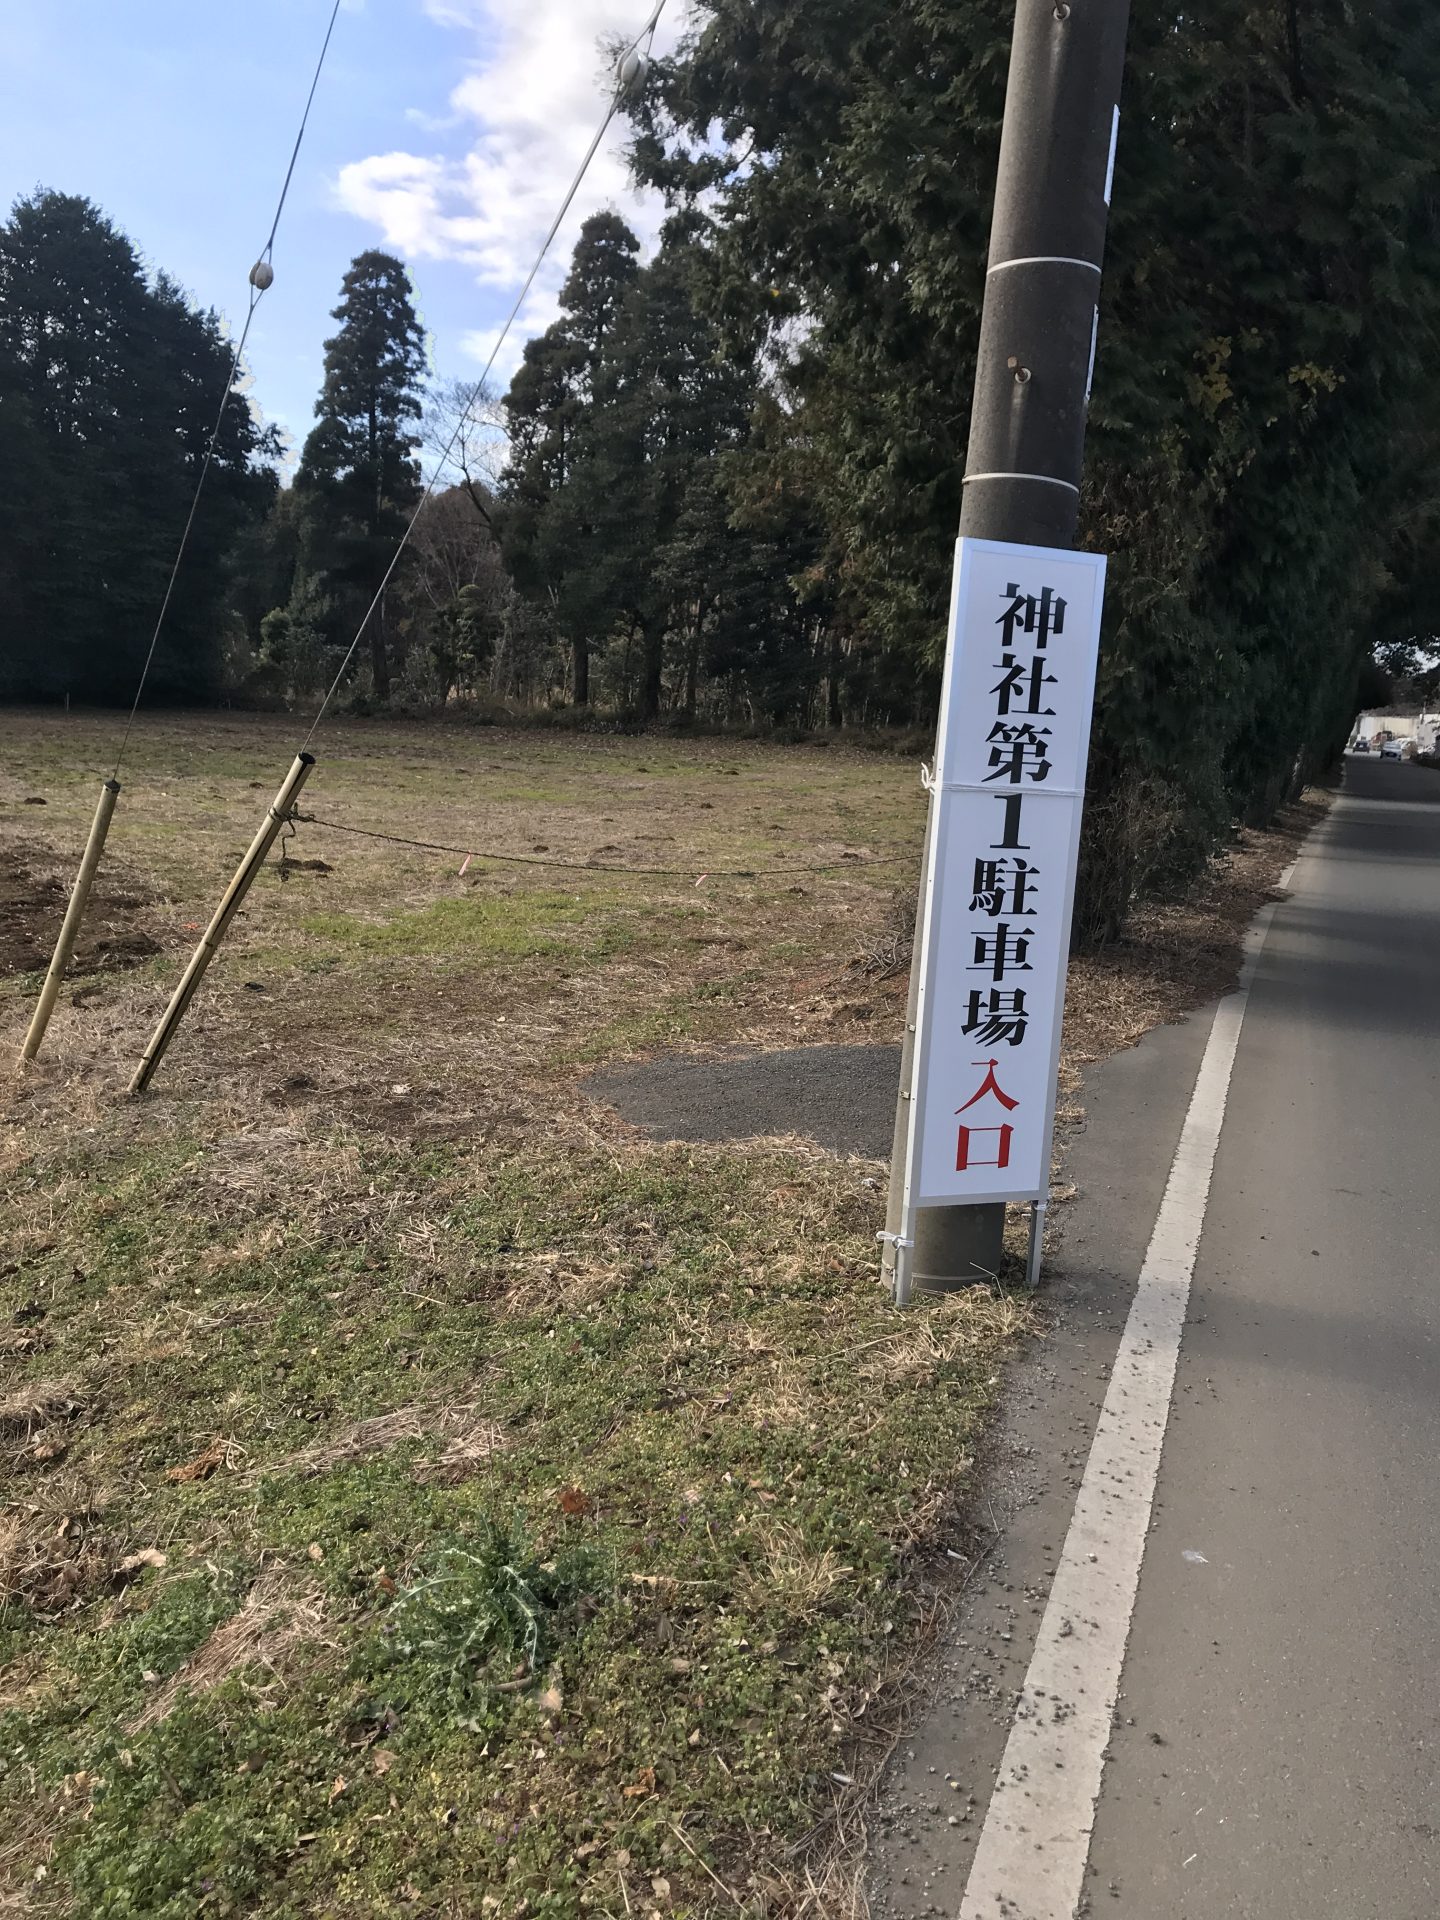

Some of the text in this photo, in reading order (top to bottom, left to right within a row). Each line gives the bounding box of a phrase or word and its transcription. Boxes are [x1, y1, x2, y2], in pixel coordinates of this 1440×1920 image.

[954, 582, 1068, 1171] 神社第1駐車場入口
